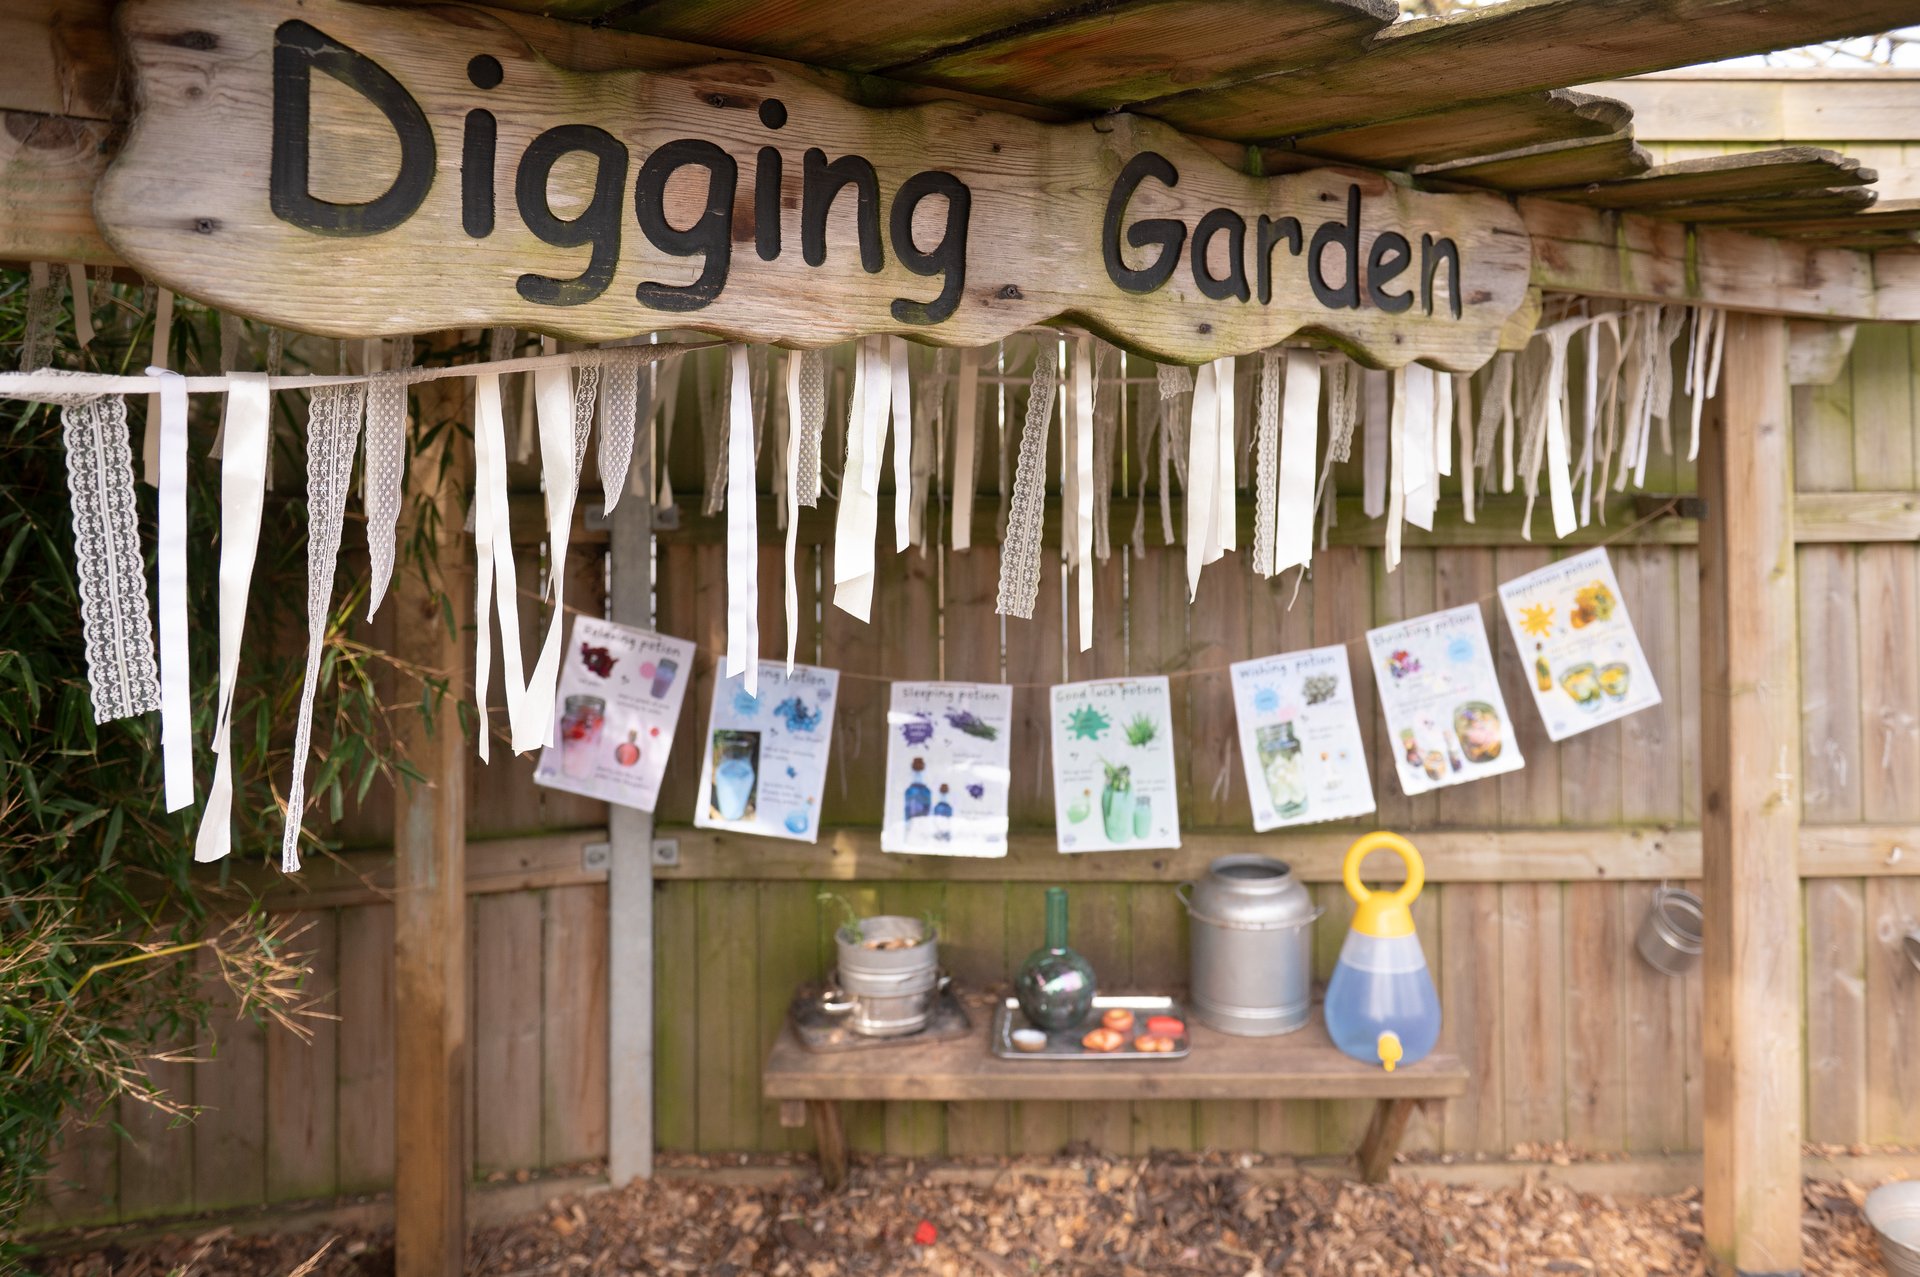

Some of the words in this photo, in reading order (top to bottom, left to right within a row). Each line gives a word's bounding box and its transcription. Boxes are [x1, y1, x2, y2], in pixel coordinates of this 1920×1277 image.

[270, 18, 972, 324] Digging
[1102, 150, 1462, 320] Garden
[1295, 654, 1335, 671] potion
[958, 688, 1001, 702] potion
[1056, 688, 1087, 701] Good
[1121, 684, 1162, 700] potion
